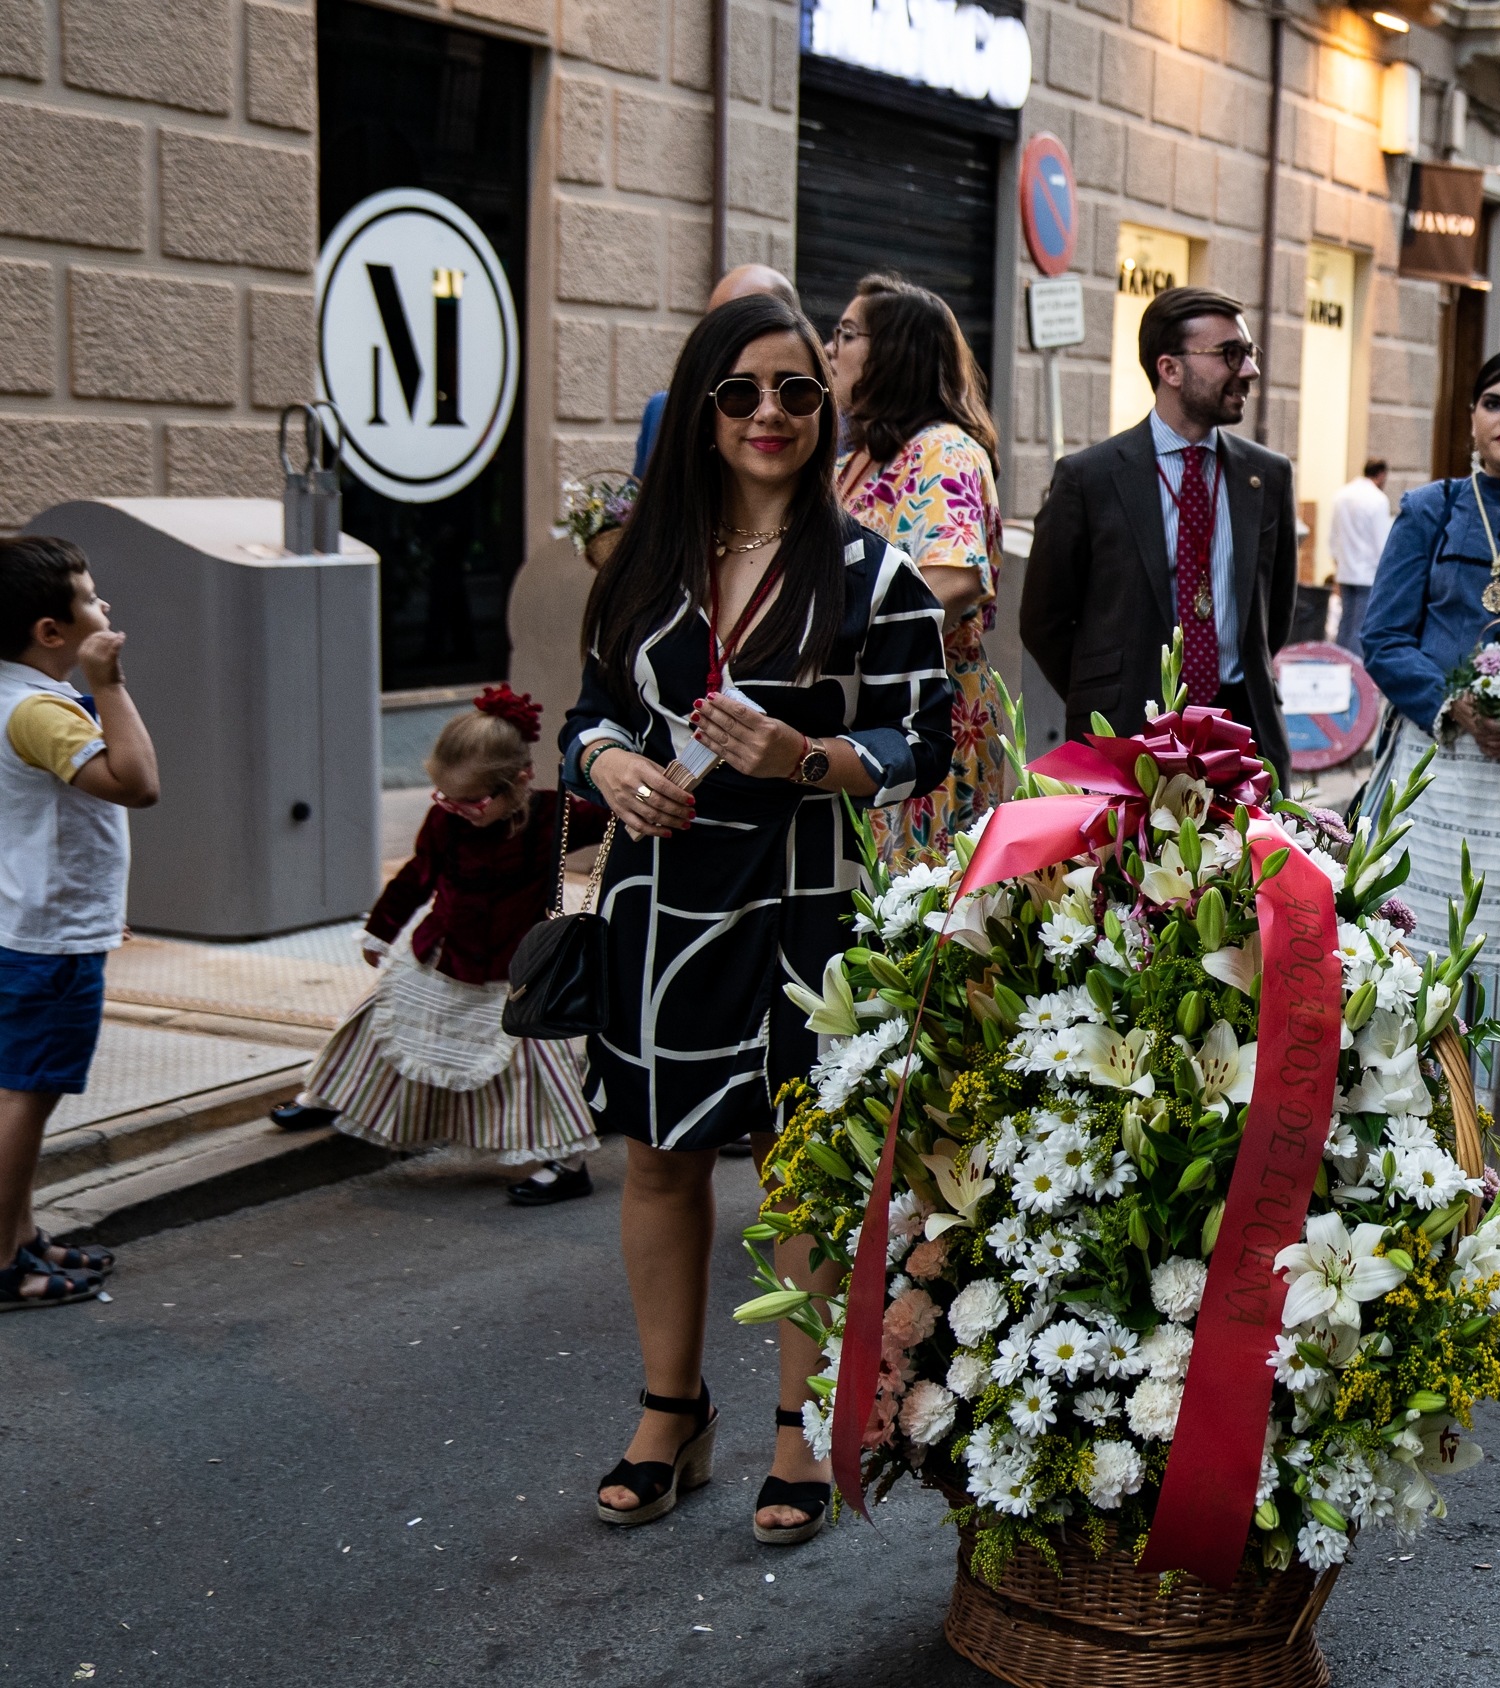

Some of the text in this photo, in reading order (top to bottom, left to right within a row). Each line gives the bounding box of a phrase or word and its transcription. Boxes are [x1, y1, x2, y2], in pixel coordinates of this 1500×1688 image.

[1408, 210, 1476, 237] MANGO
[365, 263, 468, 428] M
[1309, 299, 1343, 329] ANGO
[1225, 882, 1326, 1327] ABOGADOS DE LUCENA
